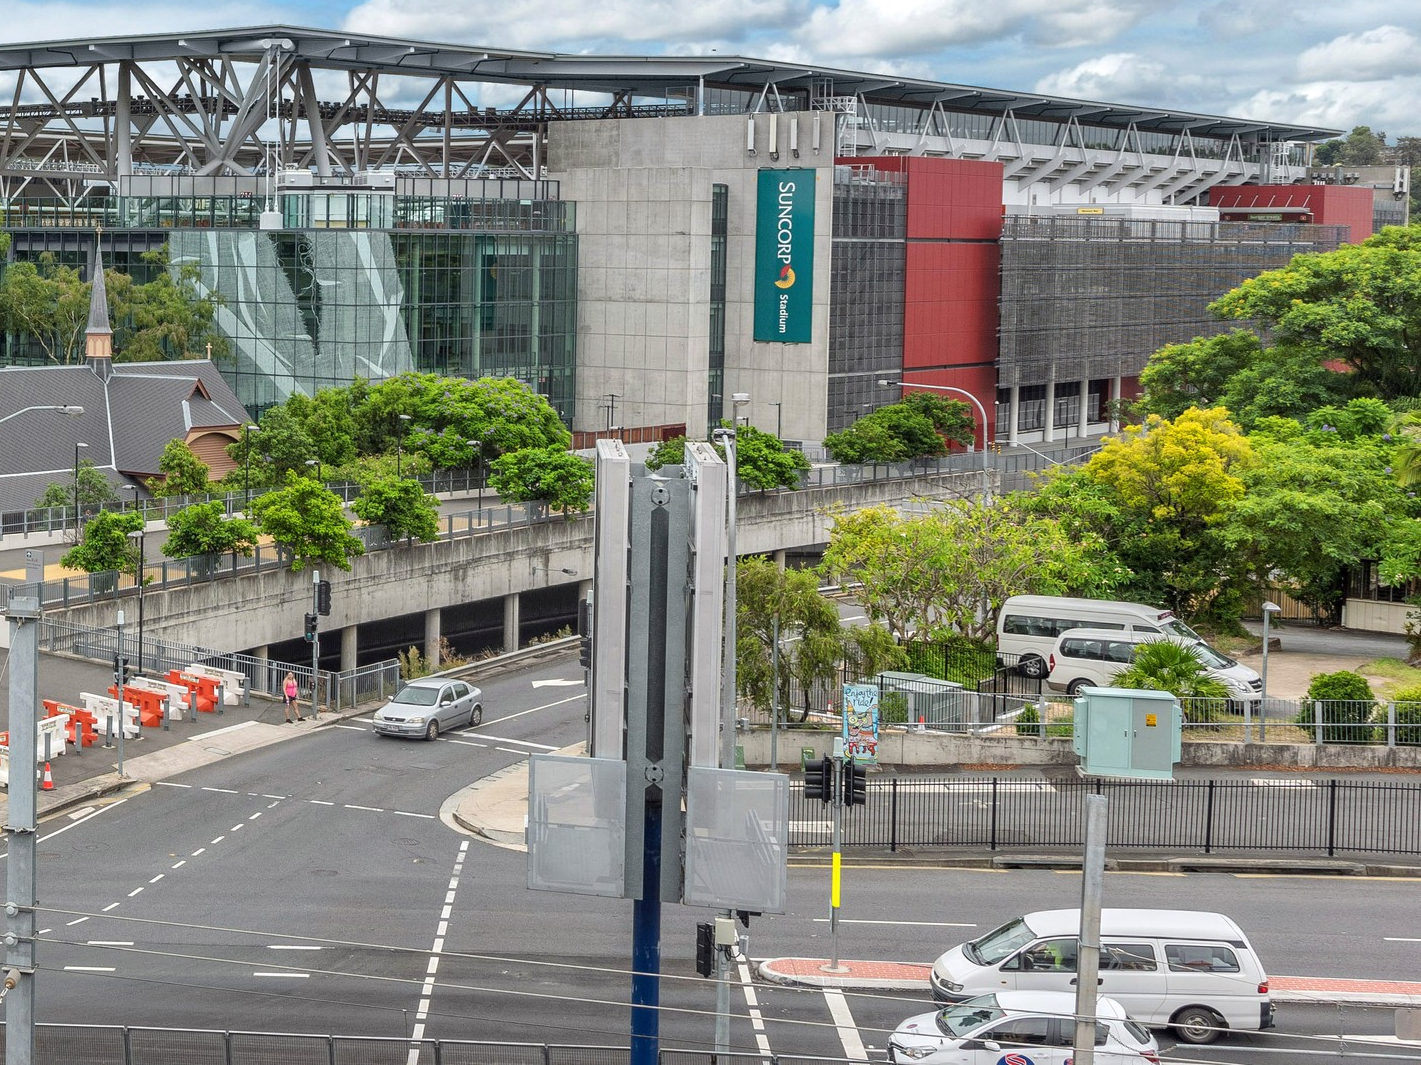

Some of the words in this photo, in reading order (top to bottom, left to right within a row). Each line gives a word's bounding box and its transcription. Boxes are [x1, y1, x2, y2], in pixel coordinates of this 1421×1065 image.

[777, 182, 796, 264] SUNCORP
[779, 294, 789, 333] Stadium
[853, 697, 874, 707] ride!
[866, 688, 878, 698] the
